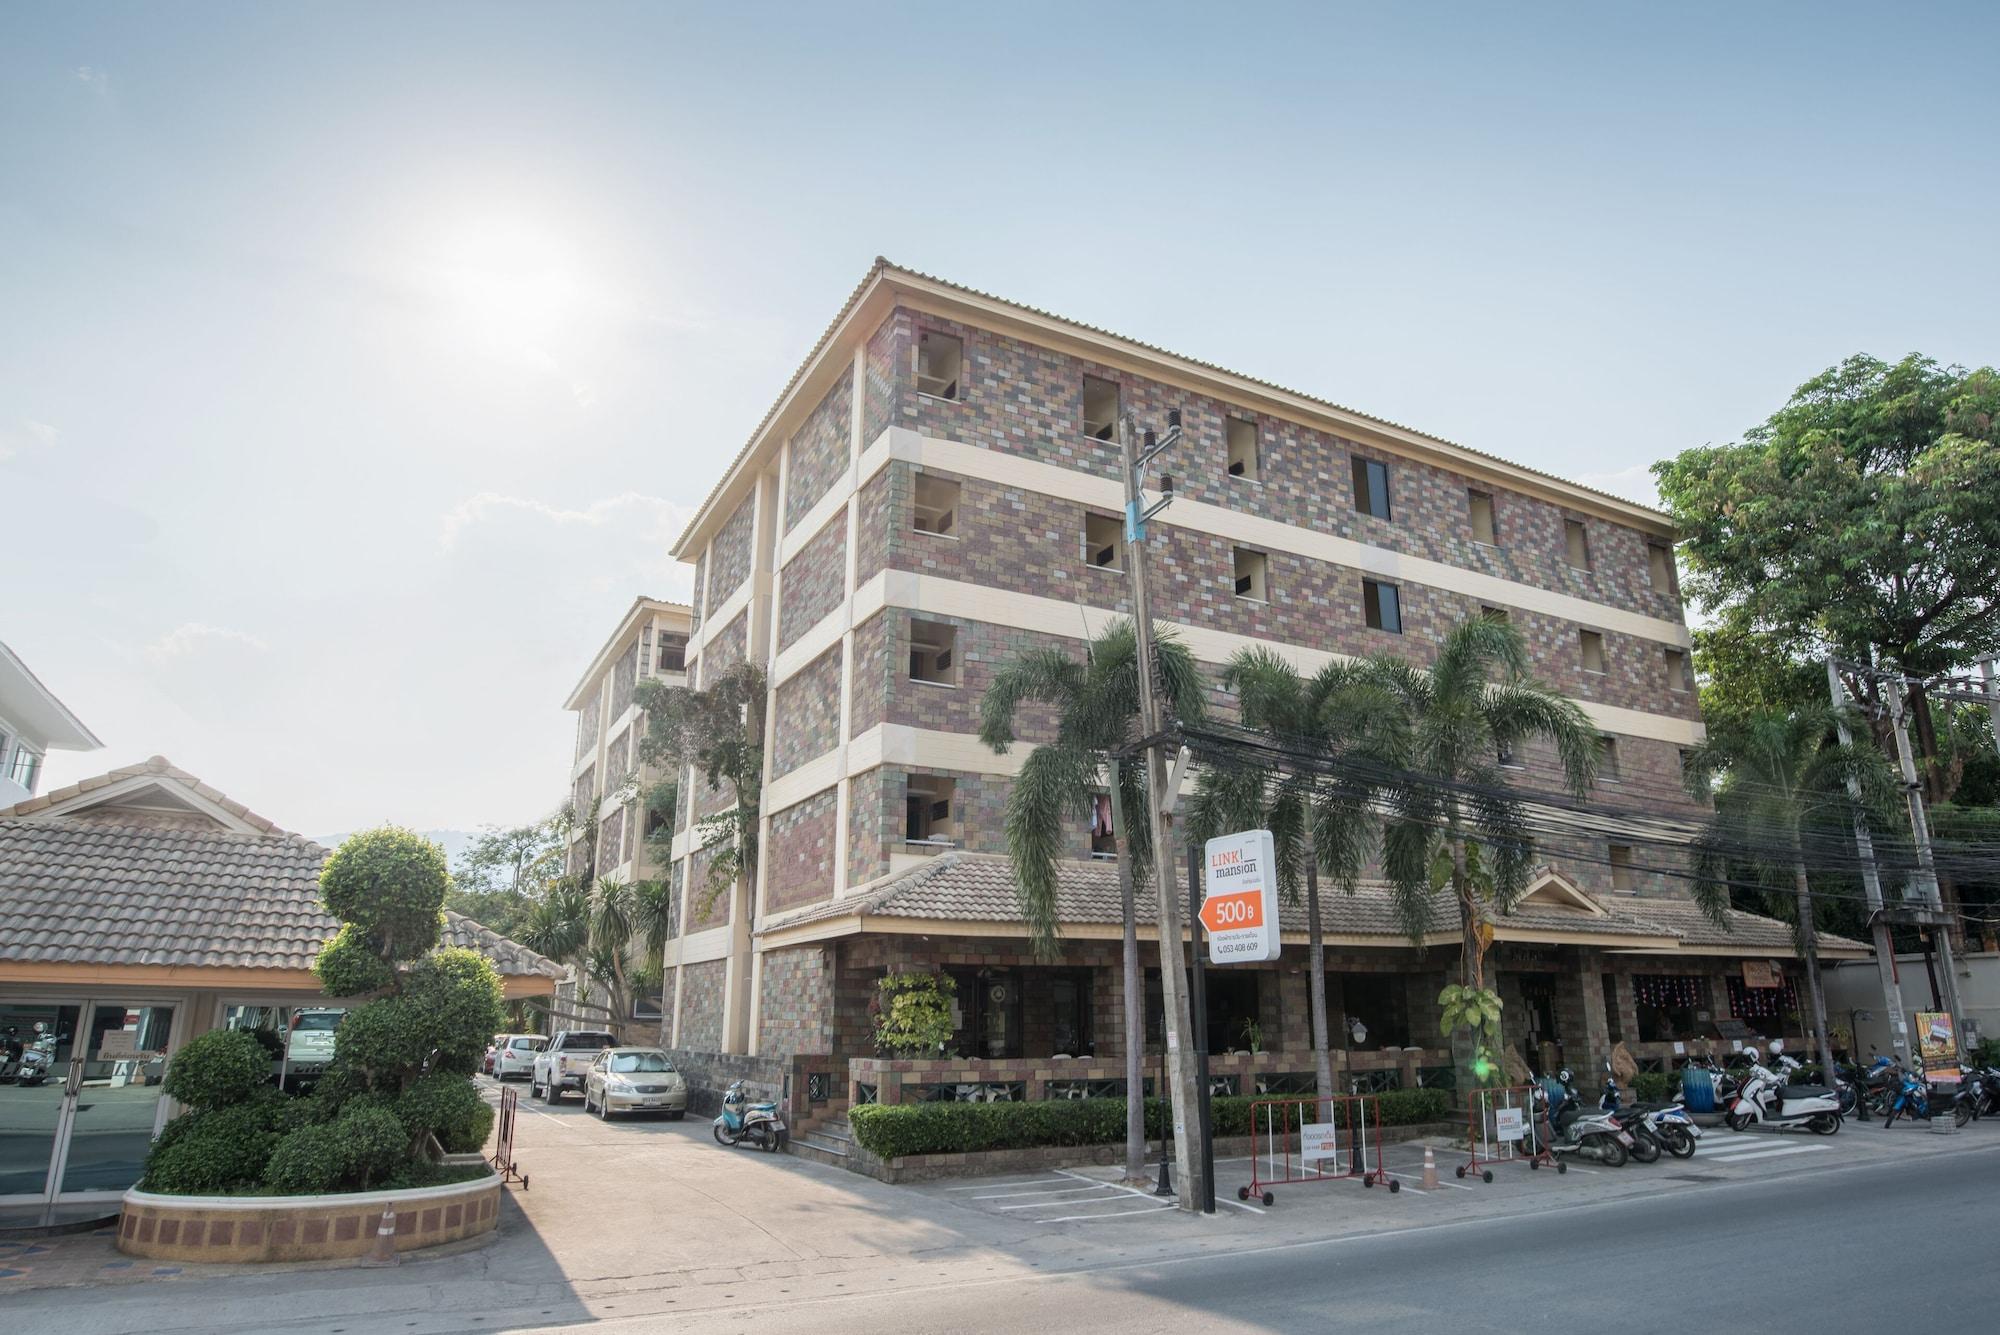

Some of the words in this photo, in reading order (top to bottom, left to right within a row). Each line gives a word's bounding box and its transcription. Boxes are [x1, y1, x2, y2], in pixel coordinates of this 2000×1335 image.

[1215, 862, 1257, 879] mansion
[1222, 944, 1234, 954] 053
[1234, 943, 1246, 953] 408
[1246, 942, 1258, 952] 609
